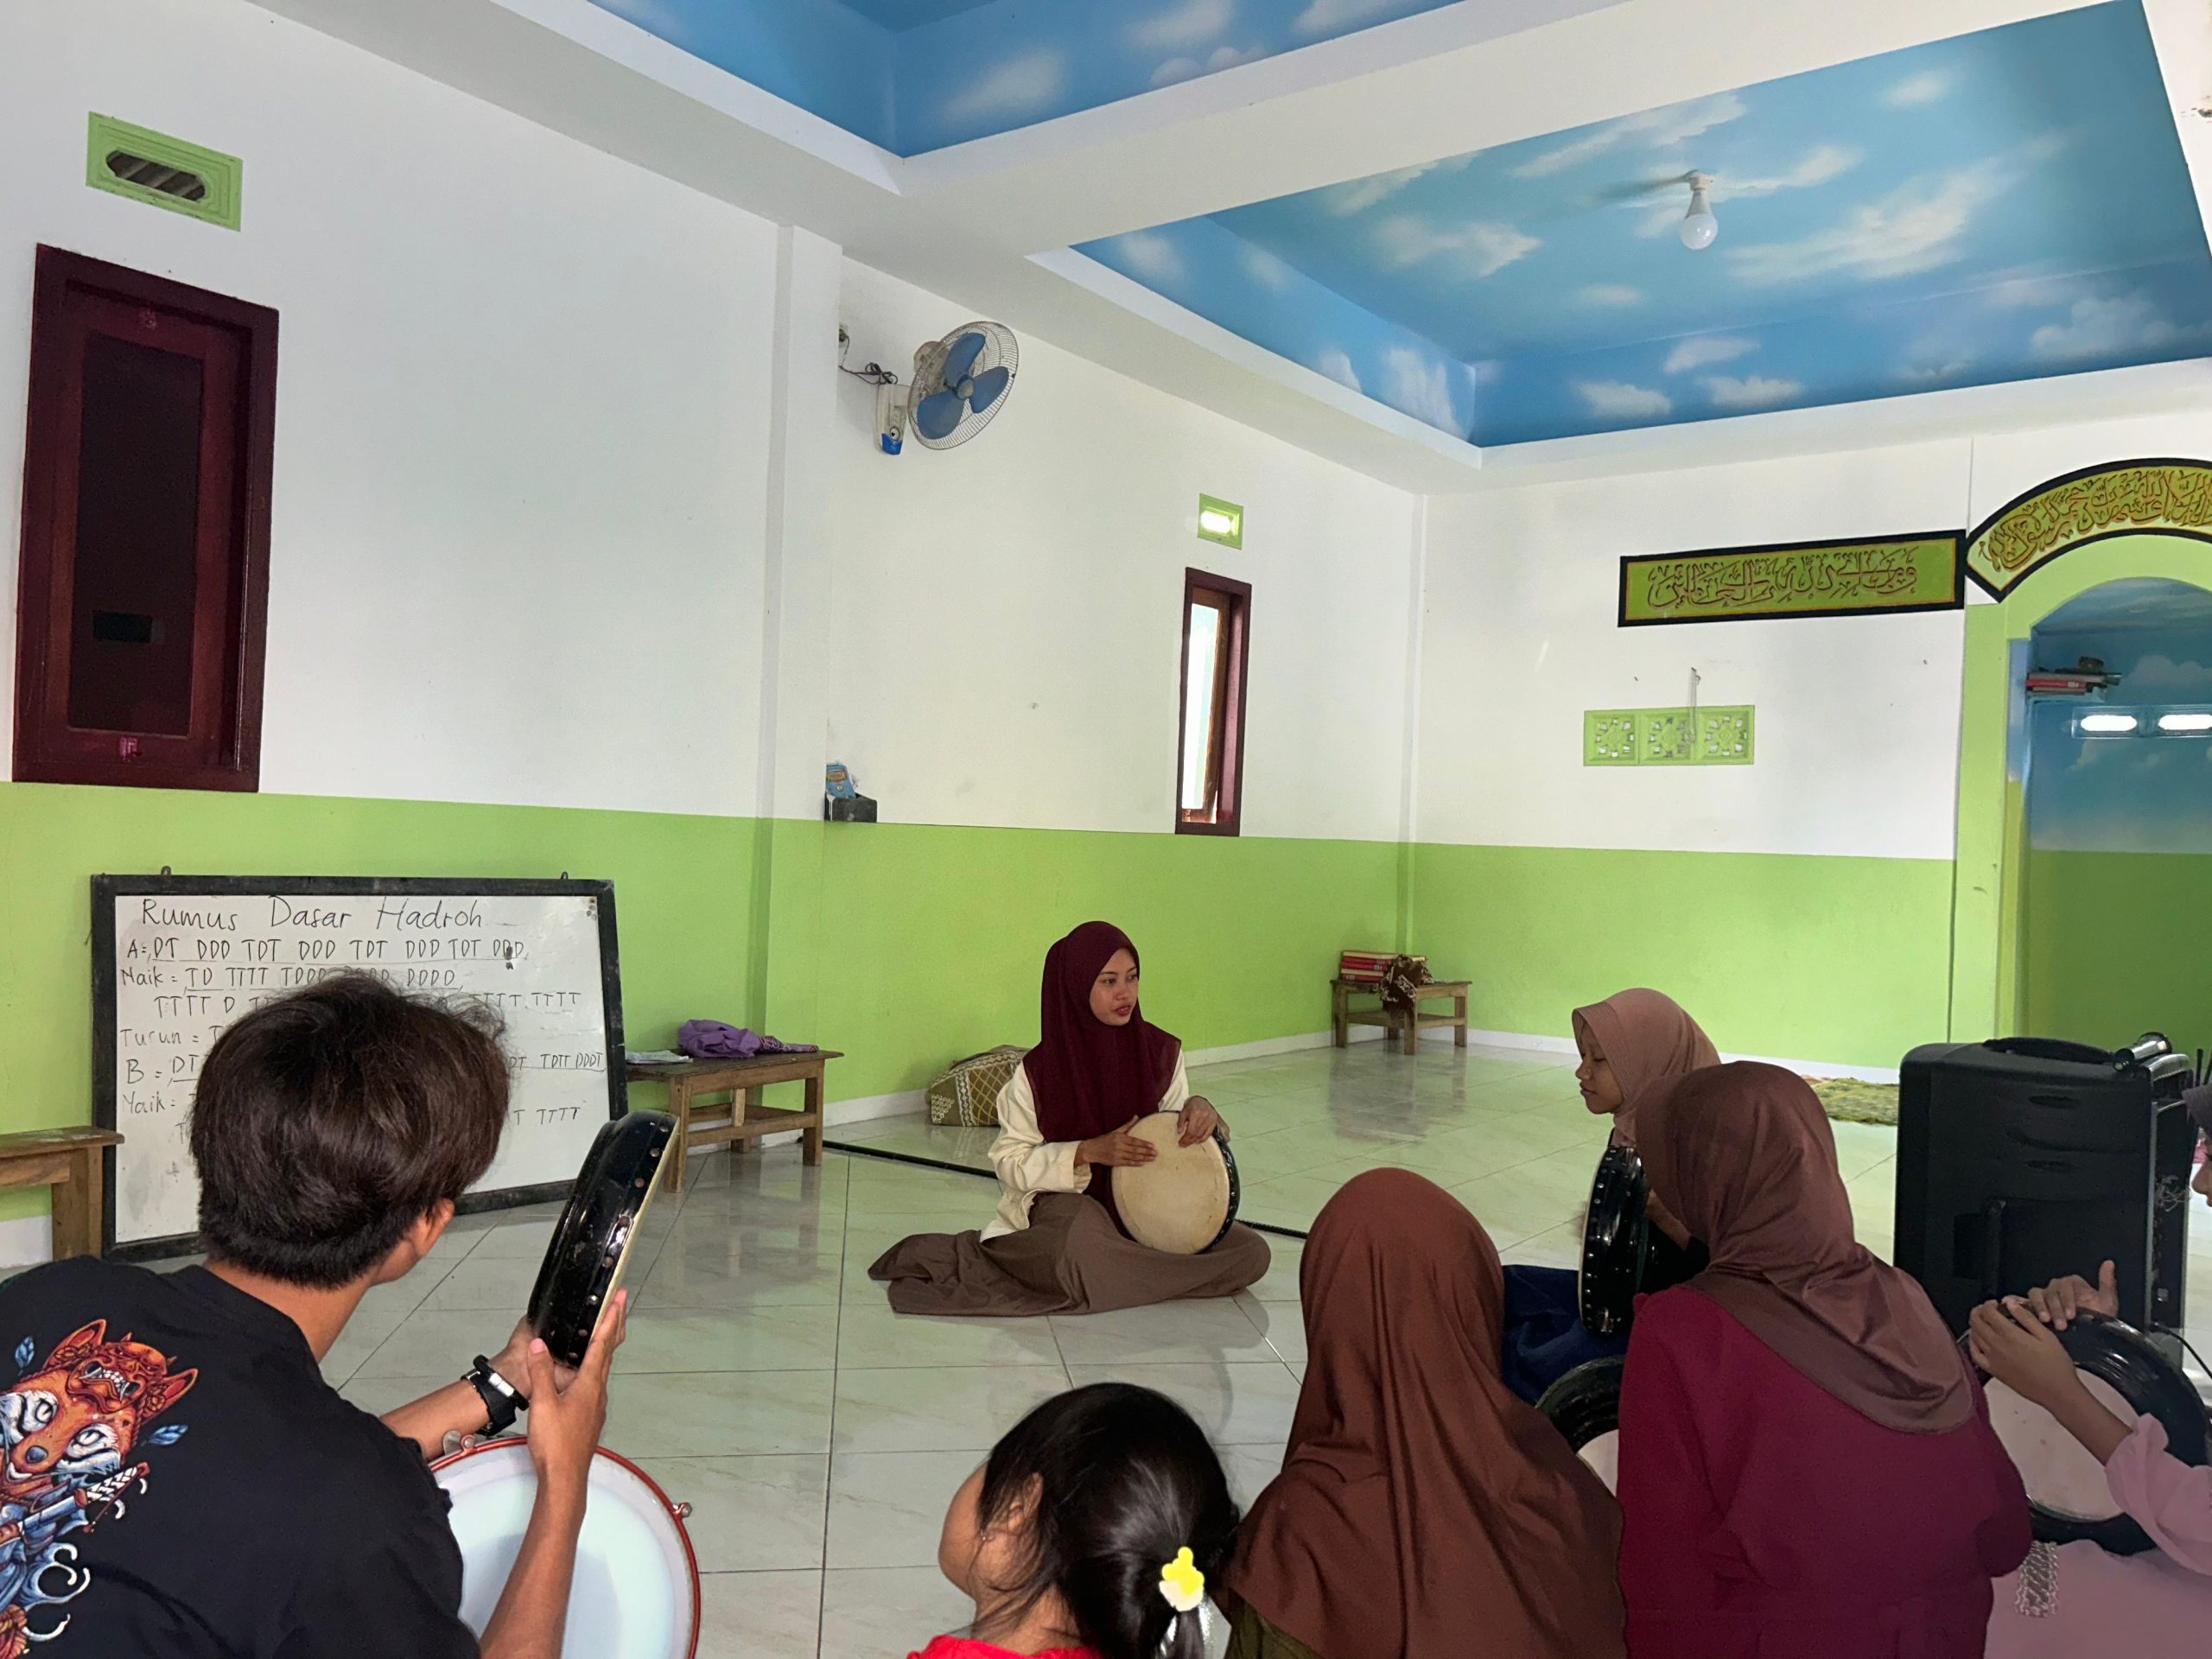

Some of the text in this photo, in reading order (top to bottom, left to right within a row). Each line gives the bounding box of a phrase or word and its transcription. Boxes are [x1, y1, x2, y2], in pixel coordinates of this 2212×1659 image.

[143, 896, 482, 931] Rumus Dasar Hadroh
[197, 939, 230, 960] DDD
[242, 939, 282, 961] TDT
[299, 940, 336, 962] DDD
[350, 940, 389, 961] TDT
[406, 940, 441, 958] DDD
[448, 938, 481, 959] TDT
